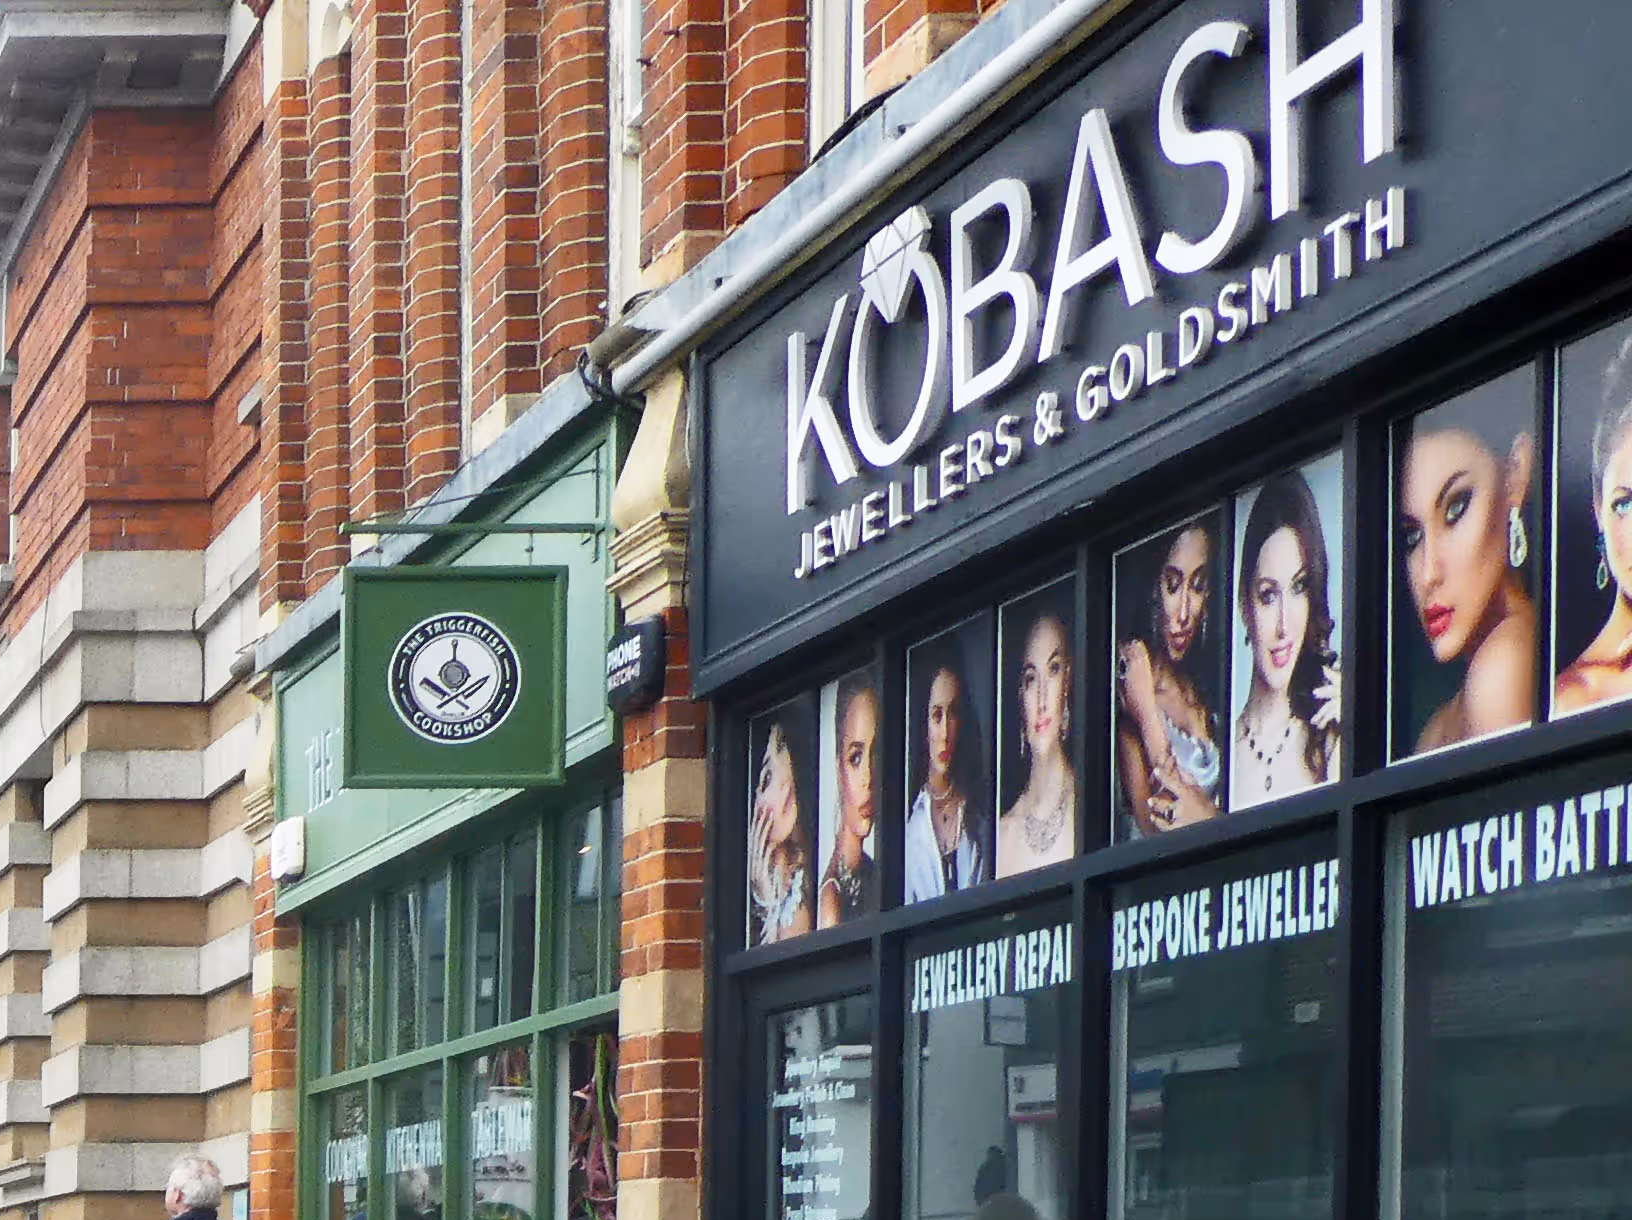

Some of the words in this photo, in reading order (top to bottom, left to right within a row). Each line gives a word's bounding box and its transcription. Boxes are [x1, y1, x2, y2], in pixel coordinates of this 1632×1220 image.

[787, 0, 1394, 516] KOBASH
[794, 413, 1020, 580] JEWELLERS
[1032, 391, 1065, 446] &
[1075, 185, 1405, 422] GOLDSMITH
[402, 632, 426, 656] THE
[425, 618, 508, 656] TRIGGERFISH
[412, 710, 494, 737] COOKSHOP
[1411, 811, 1524, 910] WATCH
[1111, 887, 1212, 972] BESPOKE
[911, 936, 1010, 1014] JEWELLERY
